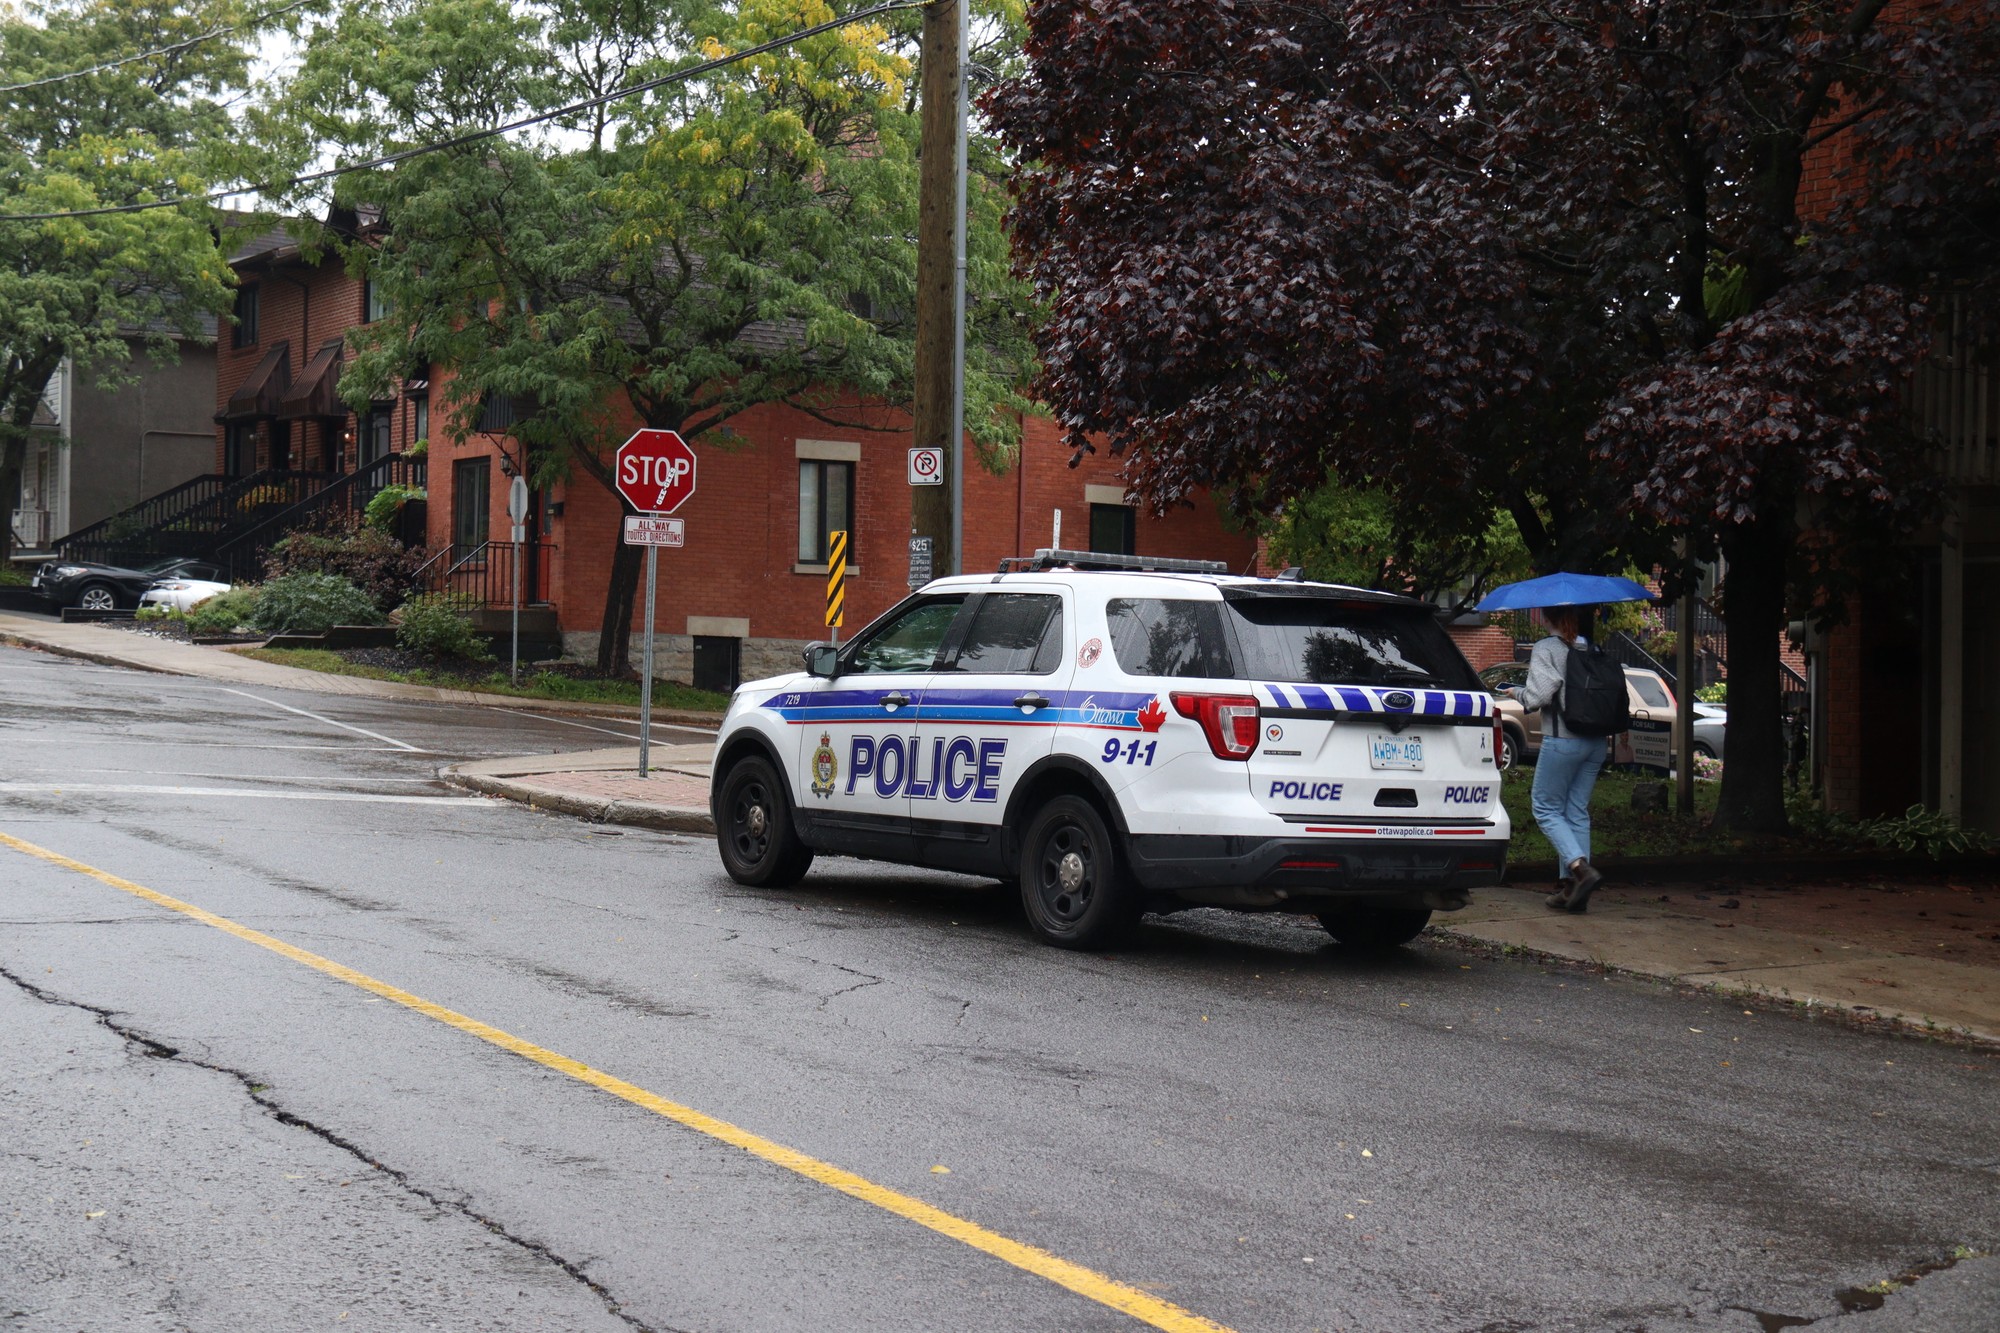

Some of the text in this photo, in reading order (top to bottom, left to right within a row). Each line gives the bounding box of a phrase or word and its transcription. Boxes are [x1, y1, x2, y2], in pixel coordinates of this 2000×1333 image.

[622, 455, 690, 487] STOP
[638, 520, 671, 531] ALL-WAY
[627, 530, 681, 543] TOUTES DIRECTIONS
[911, 539, 928, 551] $25
[785, 694, 801, 705] 7219
[1390, 694, 1409, 704] Ford
[1079, 694, 1126, 725] Ottawa
[1632, 720, 1656, 730] FOR SALE
[1101, 737, 1158, 766] 9-1-1
[844, 734, 1008, 803] POLICE
[1269, 781, 1343, 801] POLICE
[1444, 786, 1490, 804] POLICE
[1377, 827, 1434, 838] ottawapolice.ca
